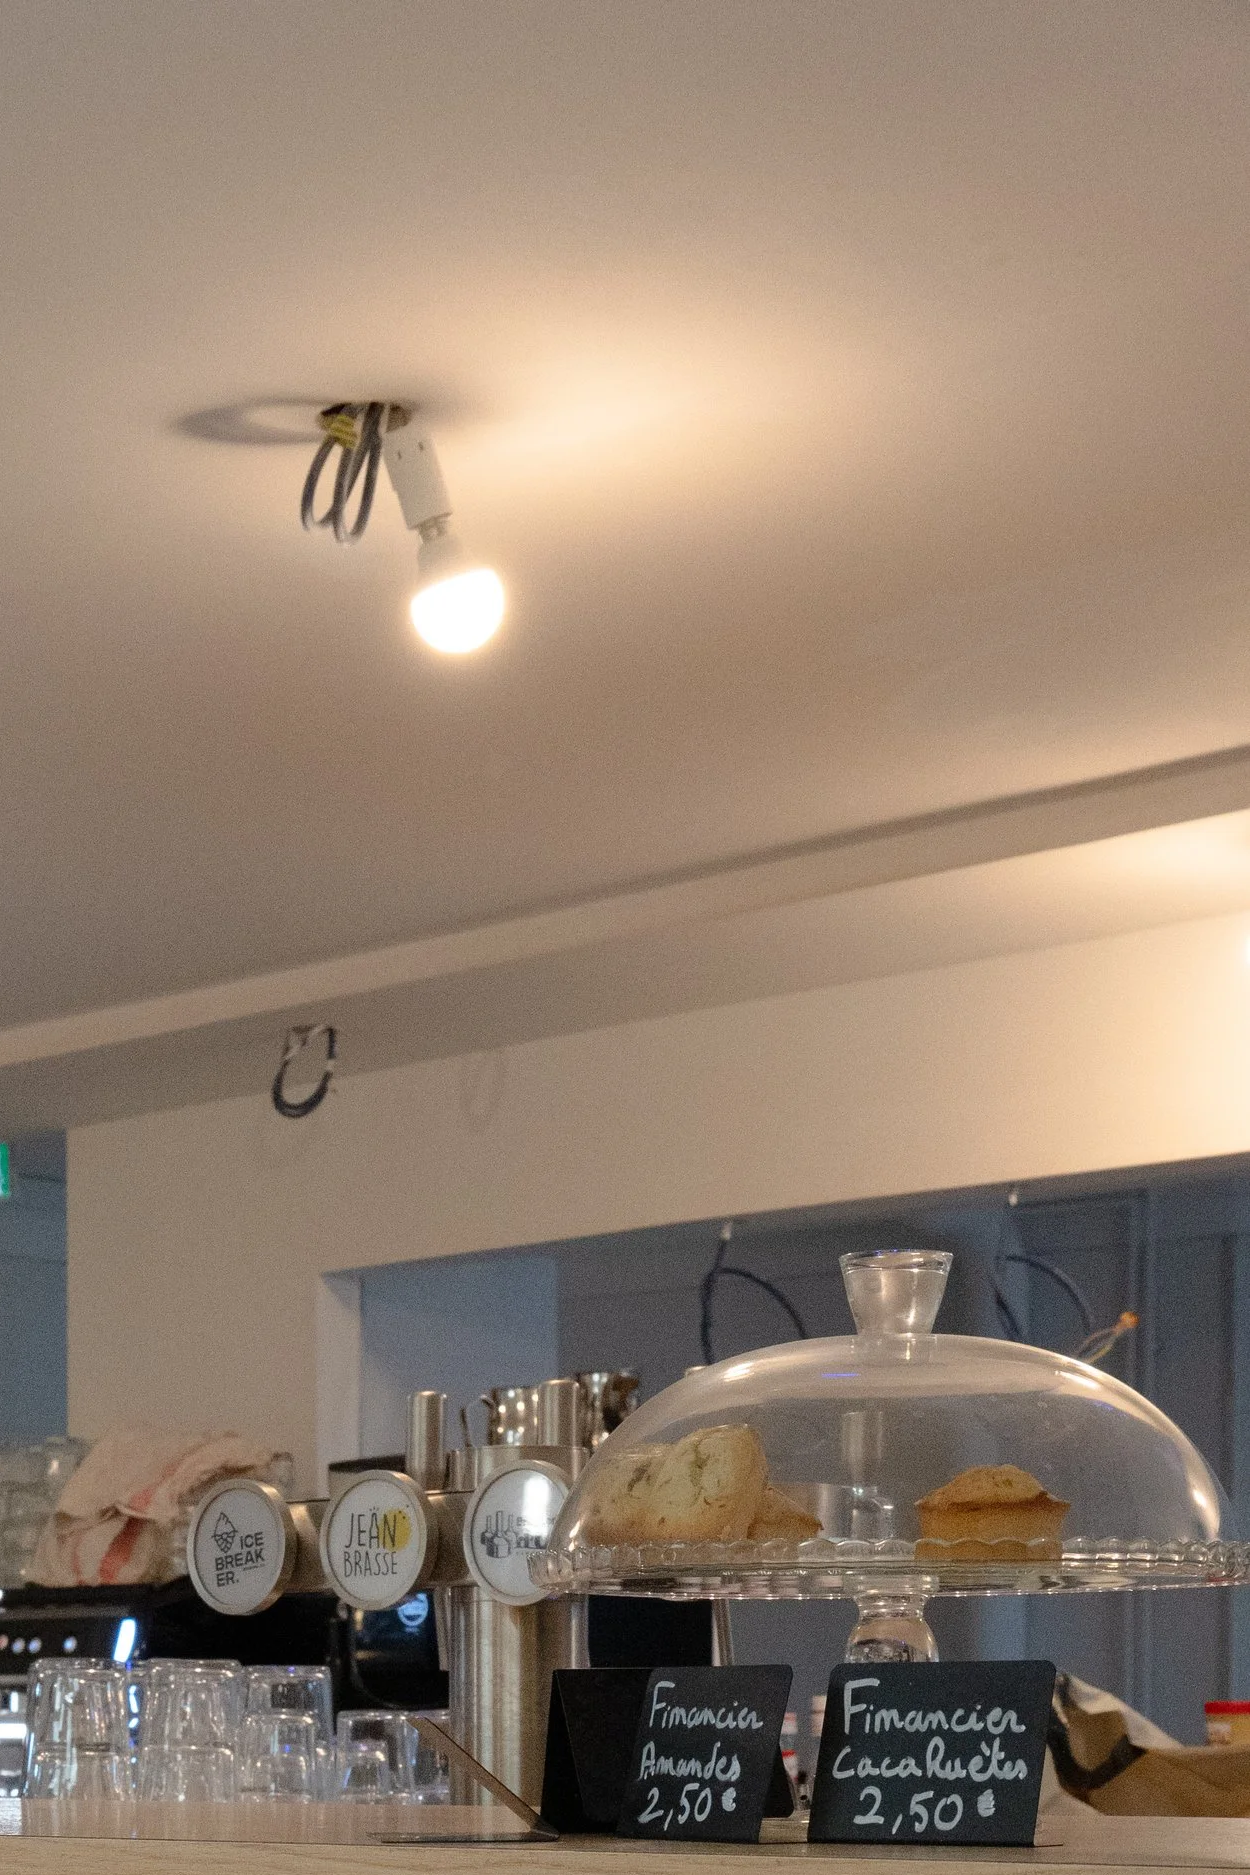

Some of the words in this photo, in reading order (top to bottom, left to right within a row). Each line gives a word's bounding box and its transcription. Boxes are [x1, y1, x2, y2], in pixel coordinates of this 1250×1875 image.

[240, 1532, 264, 1550] ICE
[215, 1548, 265, 1571] BREAK
[343, 1550, 398, 1578] BRASSE
[636, 1740, 742, 1782] Amandes
